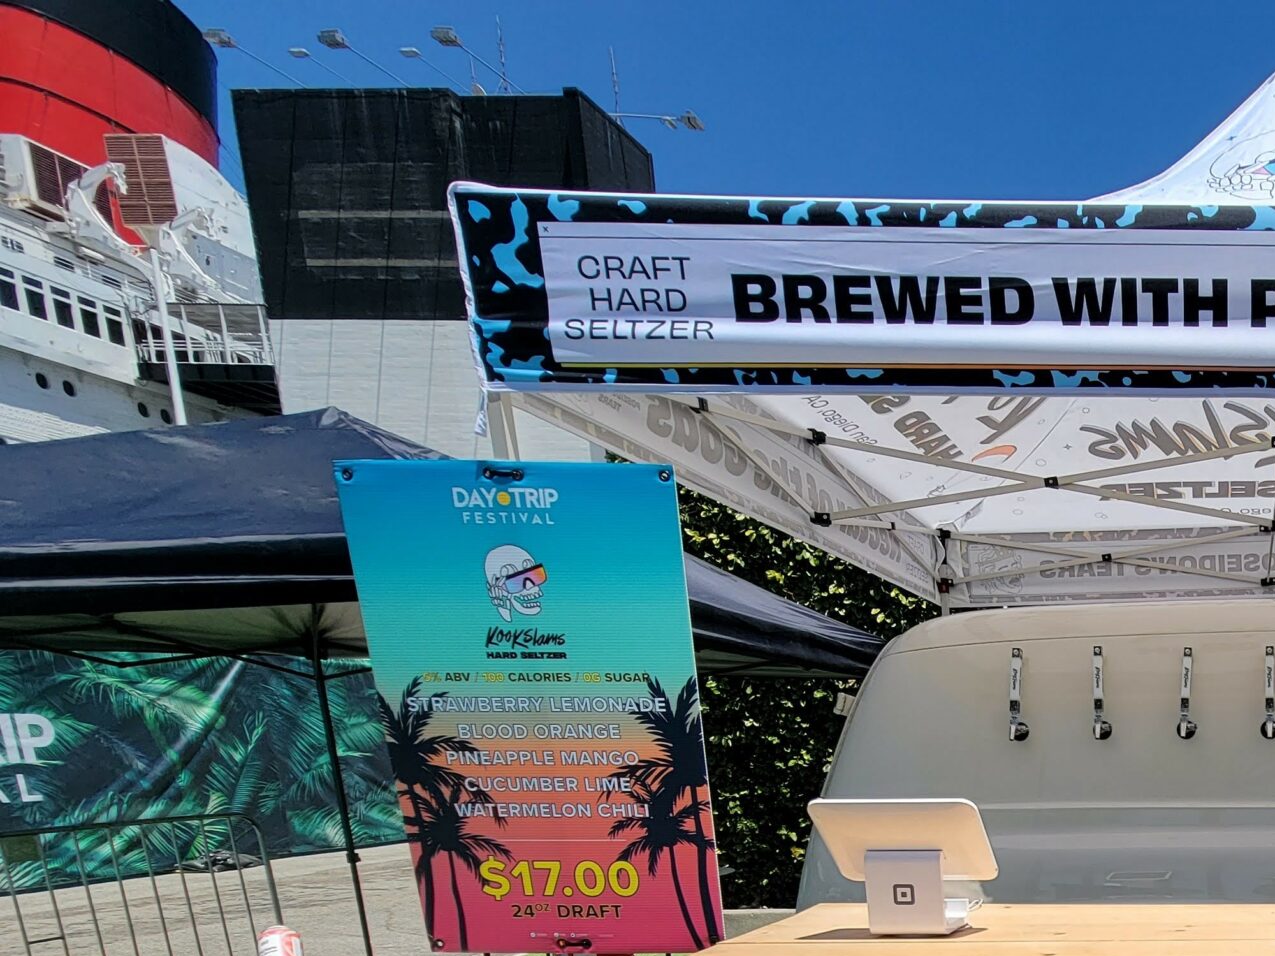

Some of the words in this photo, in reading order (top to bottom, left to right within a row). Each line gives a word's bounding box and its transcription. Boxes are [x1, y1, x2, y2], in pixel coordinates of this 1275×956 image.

[577, 255, 691, 280] CRAFT
[589, 287, 687, 312] HARD
[731, 272, 1035, 326] BREWED
[1052, 277, 1229, 328] WITH
[564, 319, 714, 340] SELTZER
[452, 486, 502, 509] DAY
[511, 487, 558, 508] TRIP
[462, 512, 555, 525] FESTIVAL
[486, 651, 517, 660] HARD
[520, 651, 567, 660] SELTZER
[445, 673, 470, 682] ABV
[508, 673, 571, 682] CALORIES
[604, 673, 651, 682] SUGAR
[407, 697, 543, 713] STRAWBERRY
[550, 696, 667, 713] LEMONADE
[458, 723, 528, 740] BLOOD
[533, 723, 621, 739] ORANGE
[445, 750, 556, 766] PINEAPPLE
[561, 750, 640, 766] MANGO
[464, 777, 578, 792] CUCUMBER
[584, 777, 632, 792] LIME
[454, 802, 592, 818] WATERMELON
[598, 803, 650, 818] CHILI
[479, 856, 640, 901] $17.00
[557, 903, 622, 919] DRAFT
